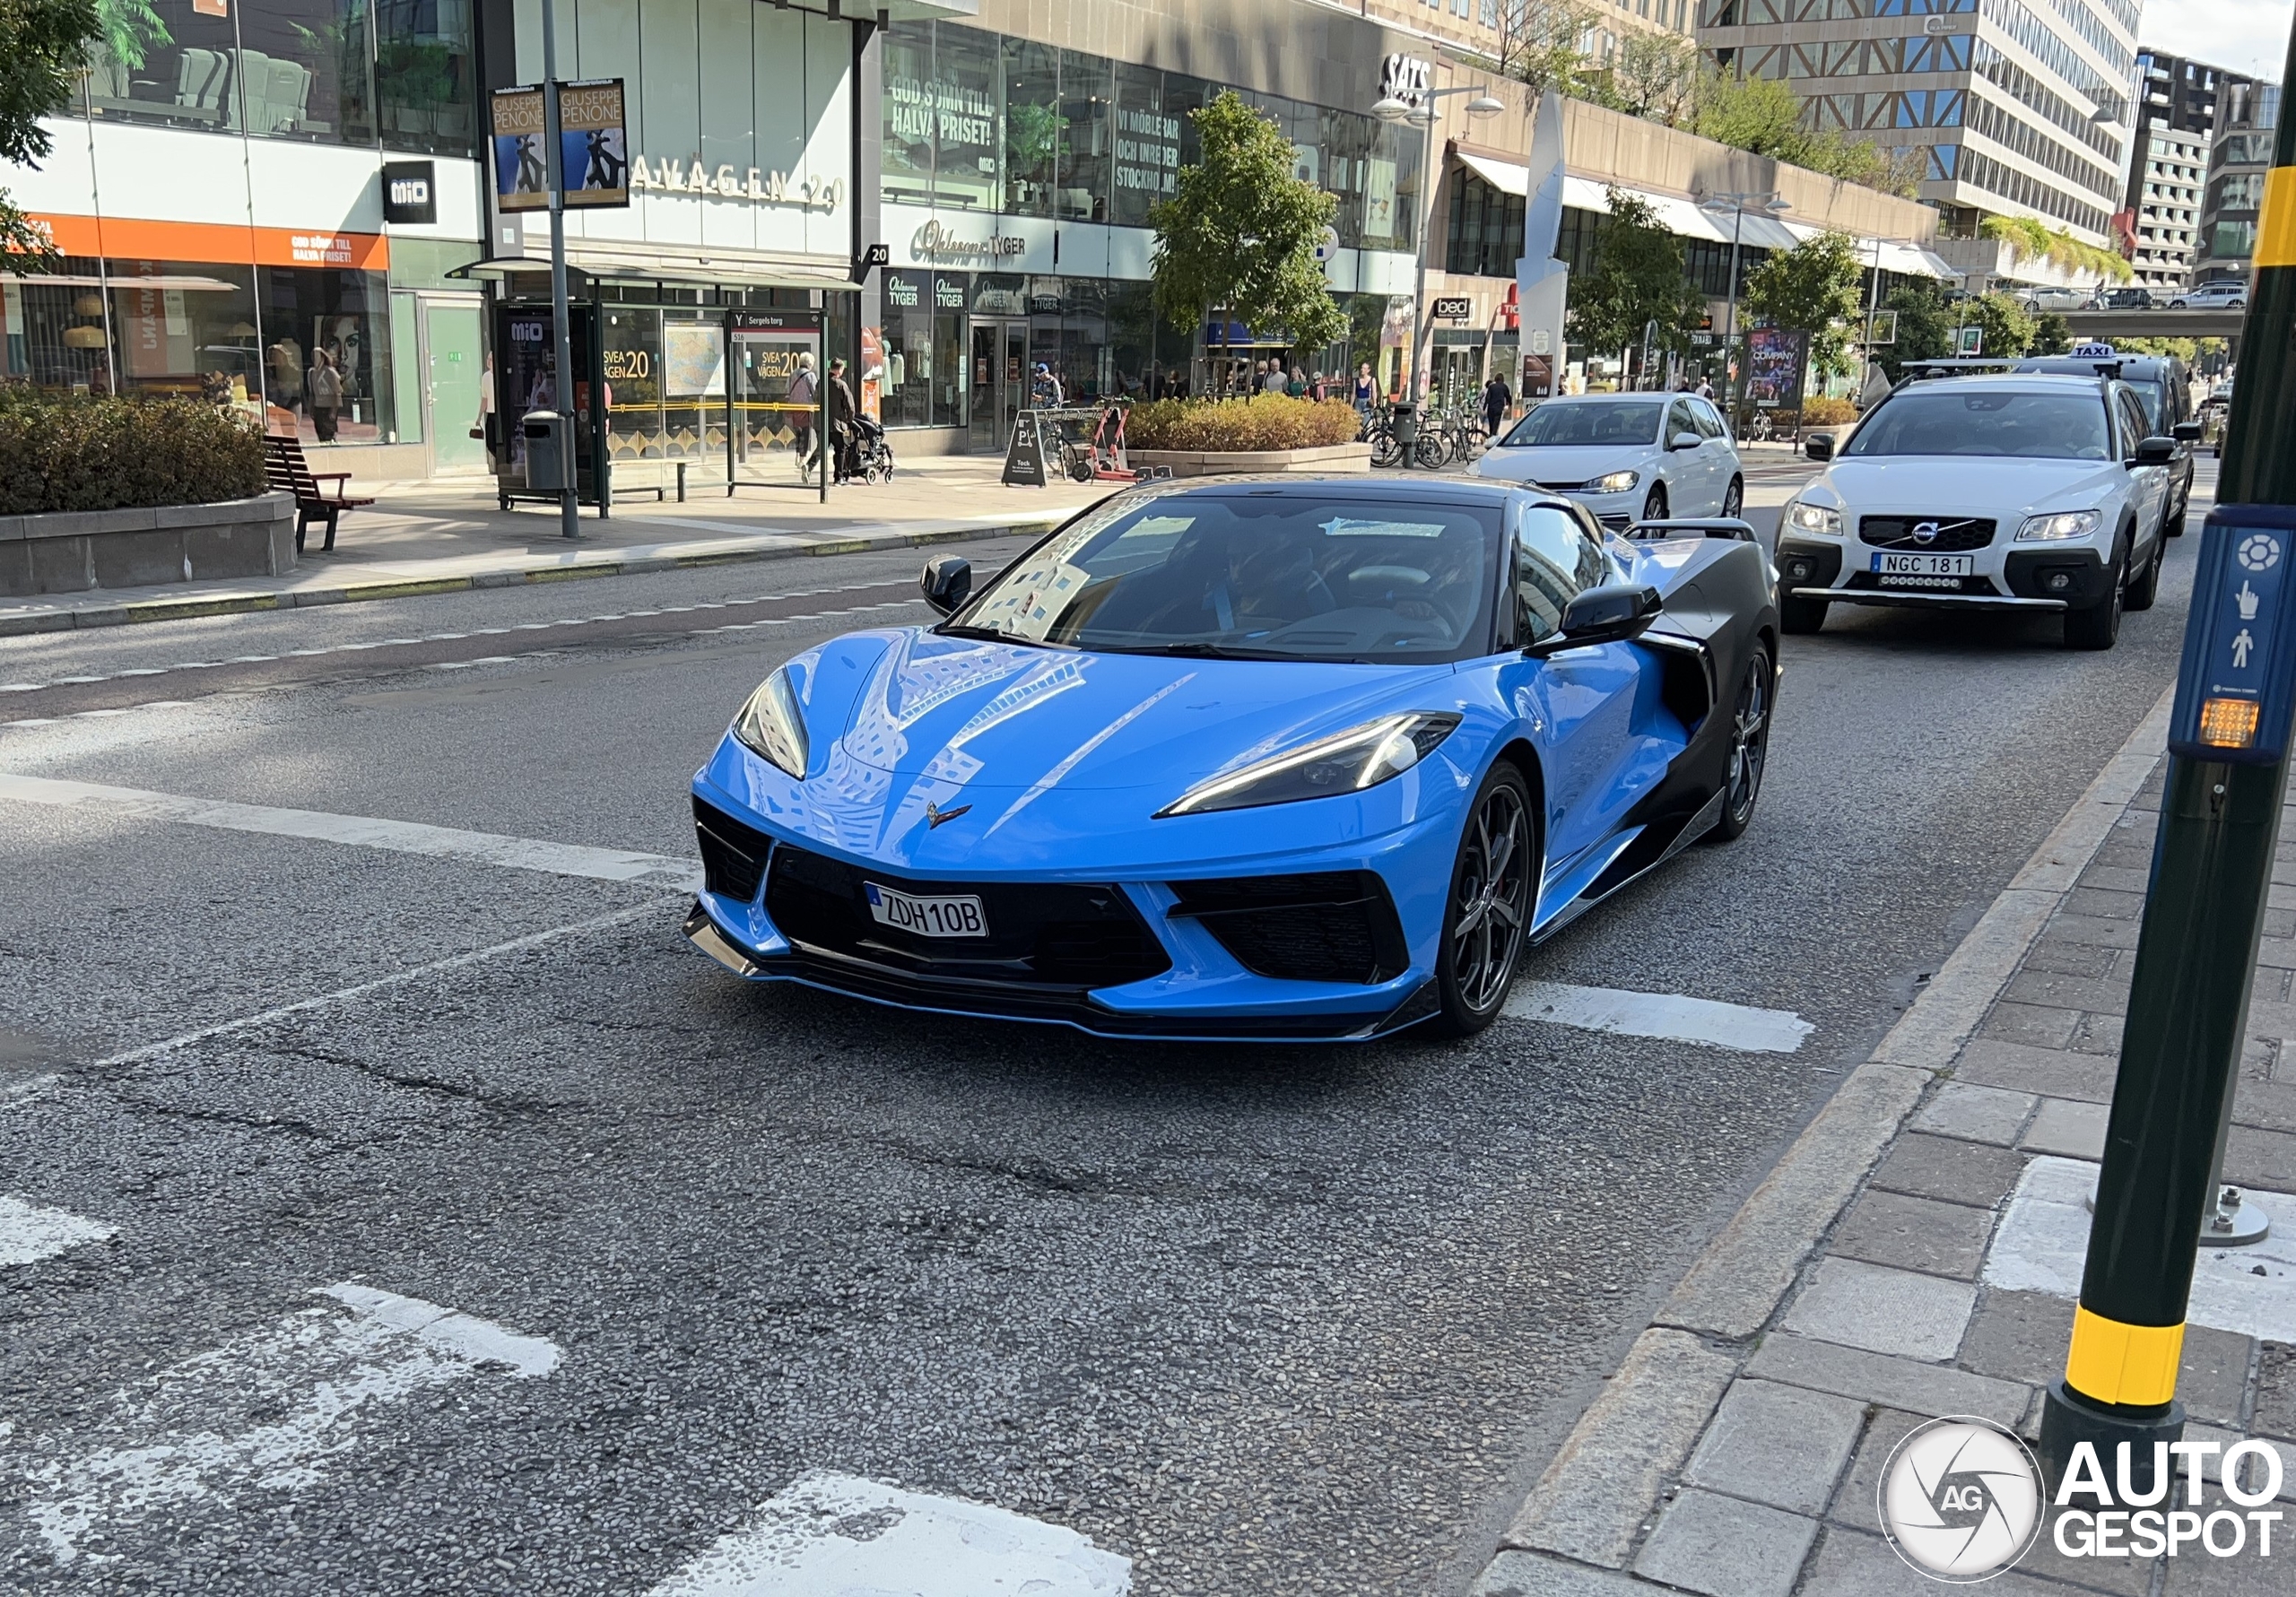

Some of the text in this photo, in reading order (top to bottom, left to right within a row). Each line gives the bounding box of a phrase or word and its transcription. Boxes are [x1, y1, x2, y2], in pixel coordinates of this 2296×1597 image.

[1385, 53, 1431, 102] SATS
[492, 94, 544, 113] GIUSEPPE
[561, 89, 622, 108] GIUSEPPE
[892, 74, 993, 117] GOD SÖMN TILL
[493, 108, 544, 128] PENONE
[561, 103, 622, 123] PENONE
[892, 106, 991, 146] HALVA PRISET!
[1118, 108, 1179, 140] VI MÖBLERAR
[1118, 138, 1178, 168] OCH INREDER
[630, 152, 787, 202] AVÄGEN
[1117, 165, 1175, 194] STOCKHOM!
[291, 236, 352, 250] GOD SÖMN TILL
[920, 219, 1025, 256] Ohlssons TYGER
[292, 249, 352, 263] HALVA PRISET!
[872, 247, 888, 262] 20
[889, 276, 918, 292] Ohlssons
[936, 278, 963, 294] Ohlssons
[139, 260, 157, 350] KMPANJ
[889, 291, 918, 307] TYGER
[936, 294, 963, 308] TYGER
[983, 294, 1008, 308] TYGER
[1034, 297, 1058, 310] TYGER
[1438, 299, 1468, 314] bed
[1504, 304, 1519, 314] TIC
[735, 314, 784, 326] Y Sergels torg
[734, 334, 744, 342] 516
[604, 350, 625, 363] SVEA
[762, 352, 781, 364] SVEA
[1753, 351, 1796, 360] COMPANY
[2075, 347, 2109, 356] TAXI
[604, 363, 626, 378] ÄGEN
[625, 350, 648, 378] 20
[757, 364, 781, 378] VÄGEN
[781, 352, 800, 378] 20
[1019, 430, 1027, 441] P
[1886, 556, 1962, 573] NGC 181
